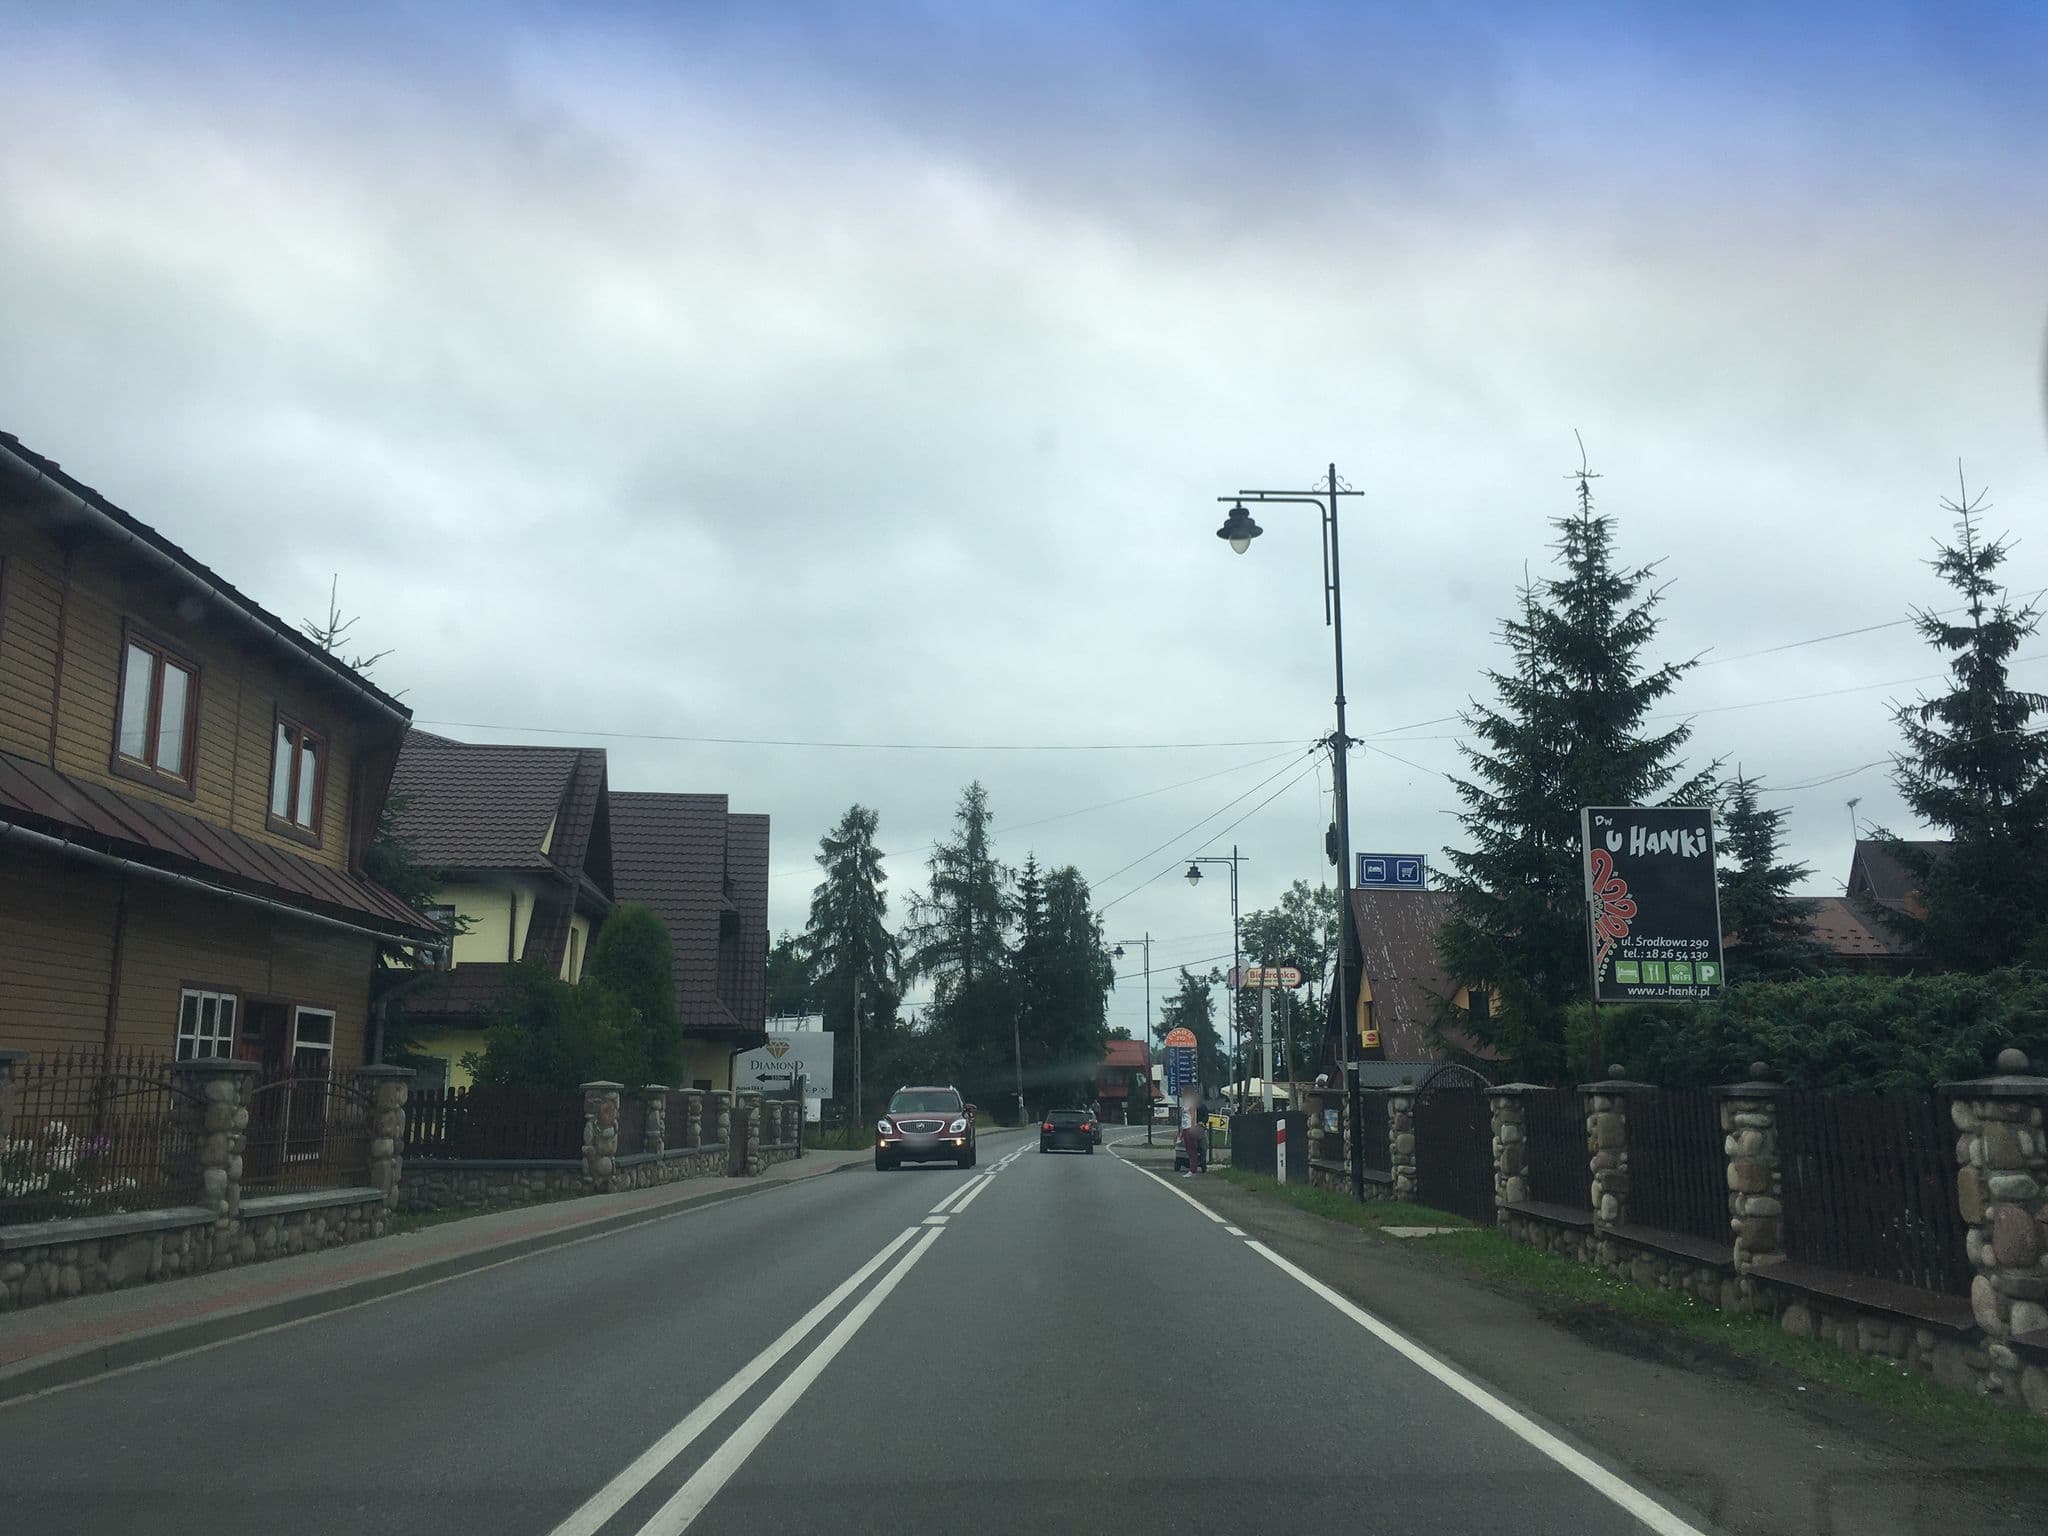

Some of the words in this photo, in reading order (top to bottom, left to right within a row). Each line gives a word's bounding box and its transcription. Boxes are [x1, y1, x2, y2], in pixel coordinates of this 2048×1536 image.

[1621, 936, 1634, 946] ul.
[1636, 935, 1687, 947] Środkowa
[1689, 940, 1709, 949] 290
[1624, 948, 1644, 958] tel.:
[1646, 949, 1658, 958] 18
[1661, 948, 1674, 958] 26
[1676, 951, 1689, 960] 54
[1692, 951, 1709, 960] 130
[1628, 986, 1710, 998] www.u-hanki.pl
[1169, 1048, 1177, 1094] SKLEP
